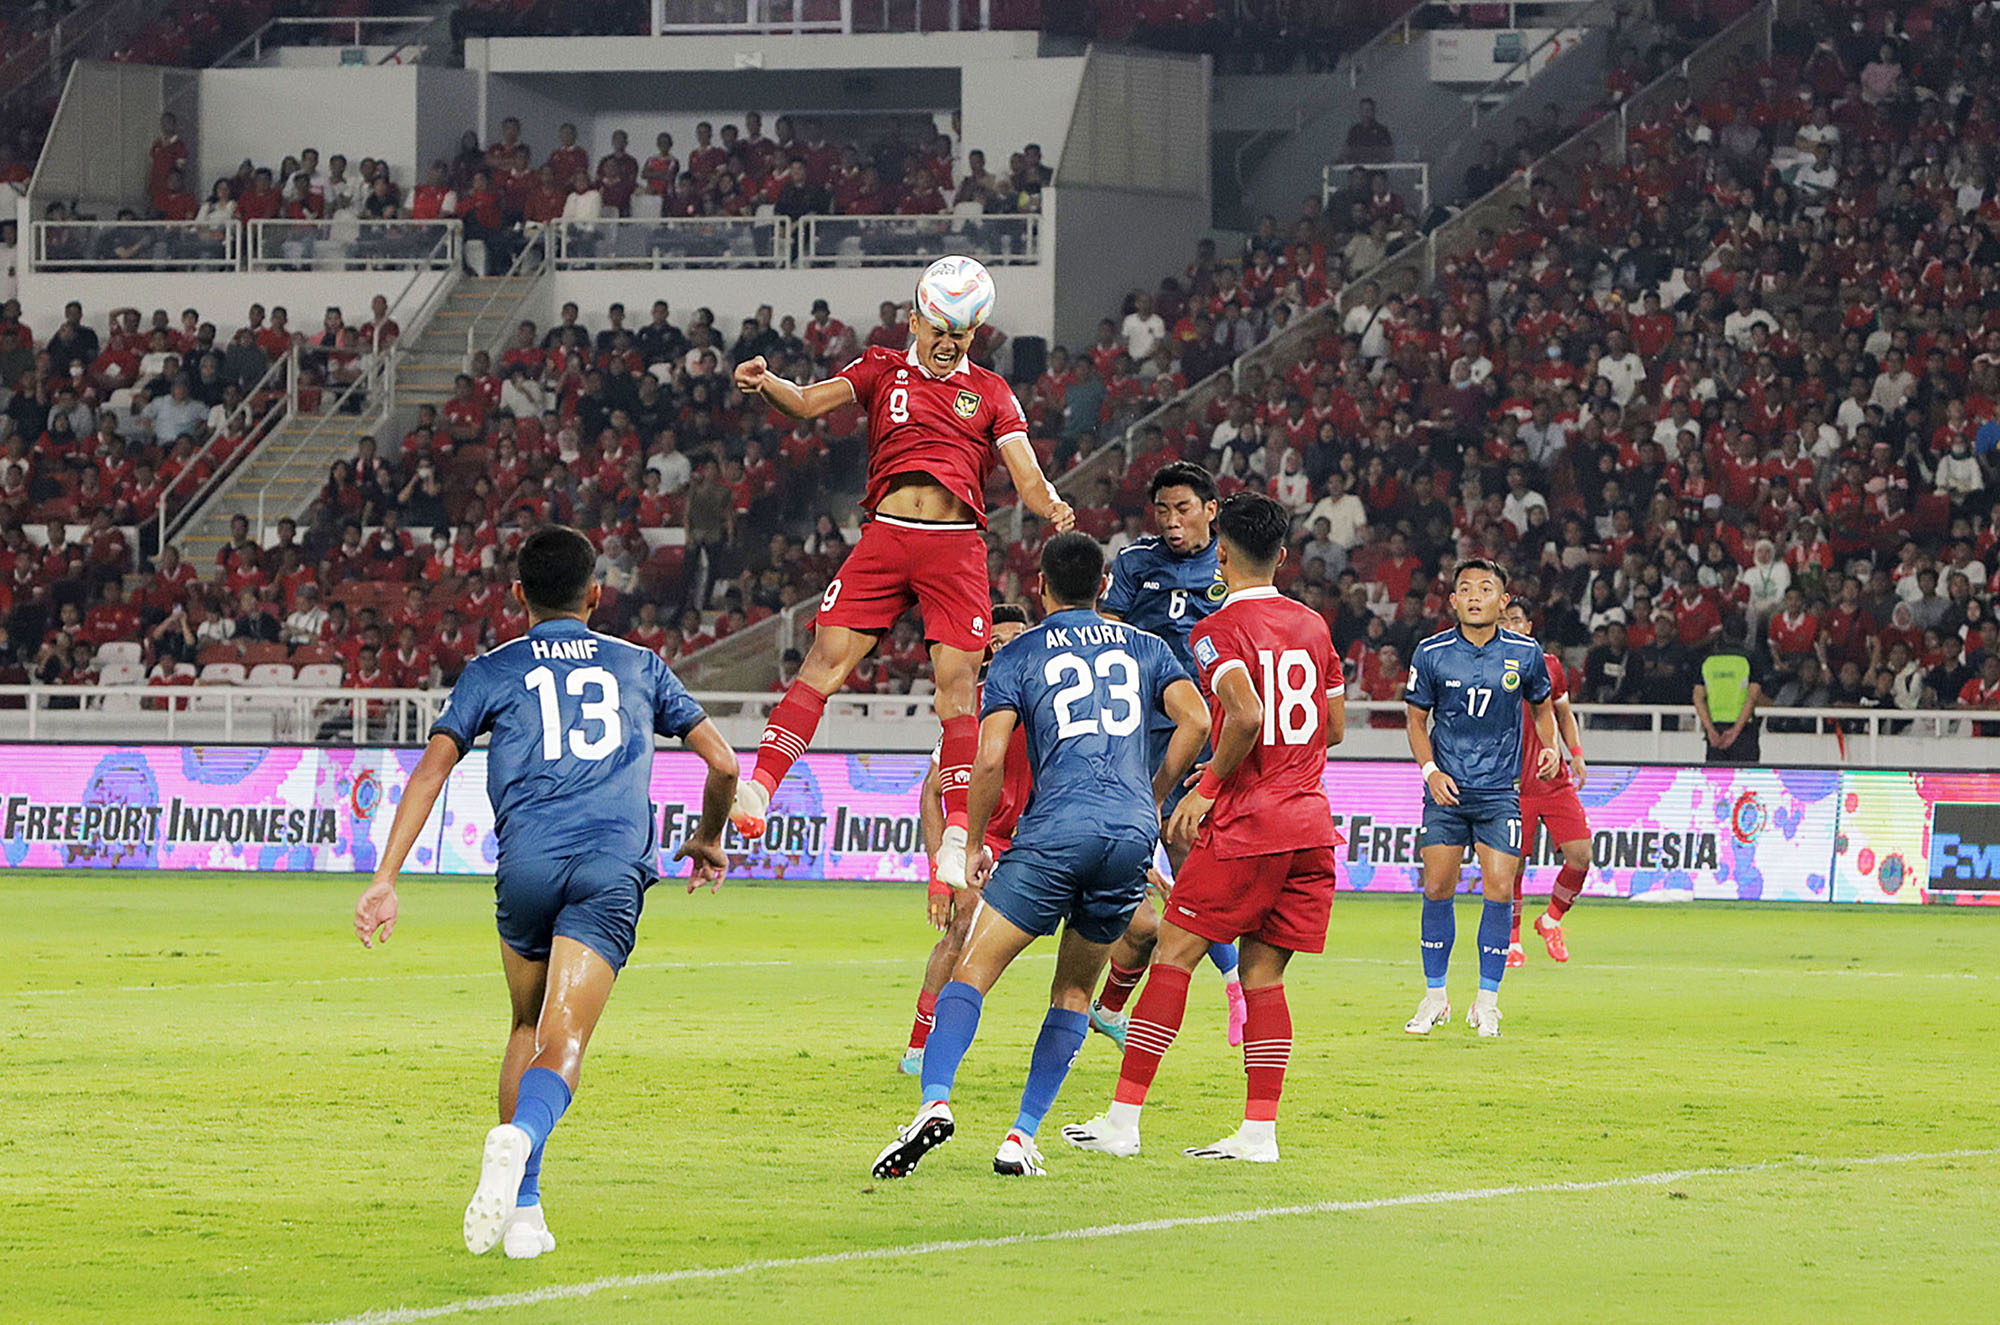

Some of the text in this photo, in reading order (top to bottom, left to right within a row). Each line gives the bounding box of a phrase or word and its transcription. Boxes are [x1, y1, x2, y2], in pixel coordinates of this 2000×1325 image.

[889, 388, 910, 423] 9
[820, 578, 842, 612] 9
[1168, 589, 1188, 619] 6
[530, 639, 598, 660] HANIF
[1046, 625, 1127, 649] AK YURA
[1044, 649, 1142, 740] 23
[1258, 649, 1319, 746] 18
[1467, 687, 1492, 717] 17
[524, 665, 622, 761] 13
[4, 797, 336, 844] FREEPORT INDONESIA
